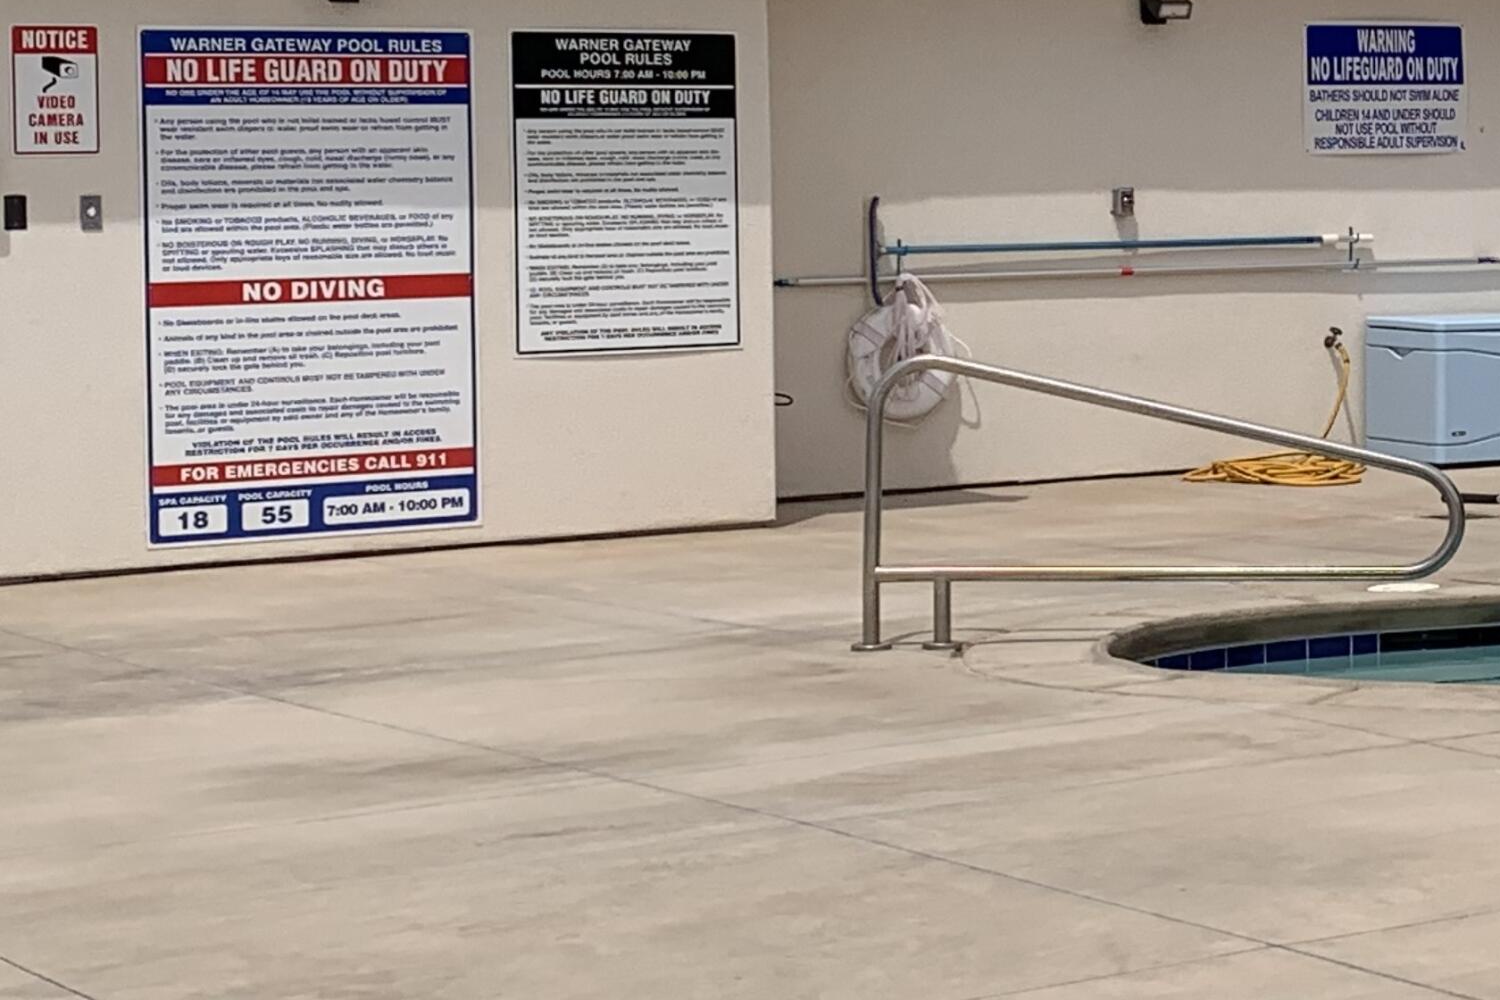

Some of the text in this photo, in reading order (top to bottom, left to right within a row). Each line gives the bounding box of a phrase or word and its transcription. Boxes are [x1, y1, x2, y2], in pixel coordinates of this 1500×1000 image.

[22, 30, 88, 49] NOTICE
[170, 37, 442, 52] WARNER GATEWAY POOL RULES
[555, 38, 691, 51] WARNER GATEWAY
[1357, 29, 1415, 53] WARNING
[580, 52, 672, 65] POOL RULES
[166, 58, 447, 82] NO LIFE GUARD ON DUTY
[541, 69, 570, 78] POOL
[573, 69, 610, 78] HOURS
[637, 69, 653, 78] AM
[690, 69, 706, 78] PM
[1311, 56, 1458, 81] NO LIFEGUARD ON DUTY
[37, 95, 75, 109] VIDEO
[540, 89, 710, 104] NO LIFE GUARD ON DUTY
[1310, 89, 1350, 102] BATHERS
[1353, 89, 1388, 102] SHOULD
[1390, 89, 1407, 102] NOT
[1433, 89, 1459, 102] ALONE
[28, 113, 84, 127] CAMERA
[1315, 109, 1359, 121] CHILDREN
[1373, 109, 1390, 121] AND
[1392, 109, 1420, 121] UNDER
[1423, 109, 1455, 121] SHOULD
[1335, 122, 1437, 135] NOT USE POOL WITHOUT
[34, 131, 80, 145] IN USE
[1315, 136, 1458, 149] RESPONSIBLE ADULT SUPERVISION
[242, 278, 384, 301] NO DIVING
[180, 451, 446, 482] FOR EMERGENCIES CALL 911
[365, 480, 428, 492] POOL HOURS
[157, 494, 226, 506] SPA CAPACITY
[237, 488, 312, 501] POOL CAPACITY
[326, 503, 357, 516] 7:00
[362, 501, 385, 514] AM
[398, 498, 437, 511] 10:00
[441, 496, 463, 508] PM
[178, 510, 208, 530] 18
[261, 504, 292, 524] 55
